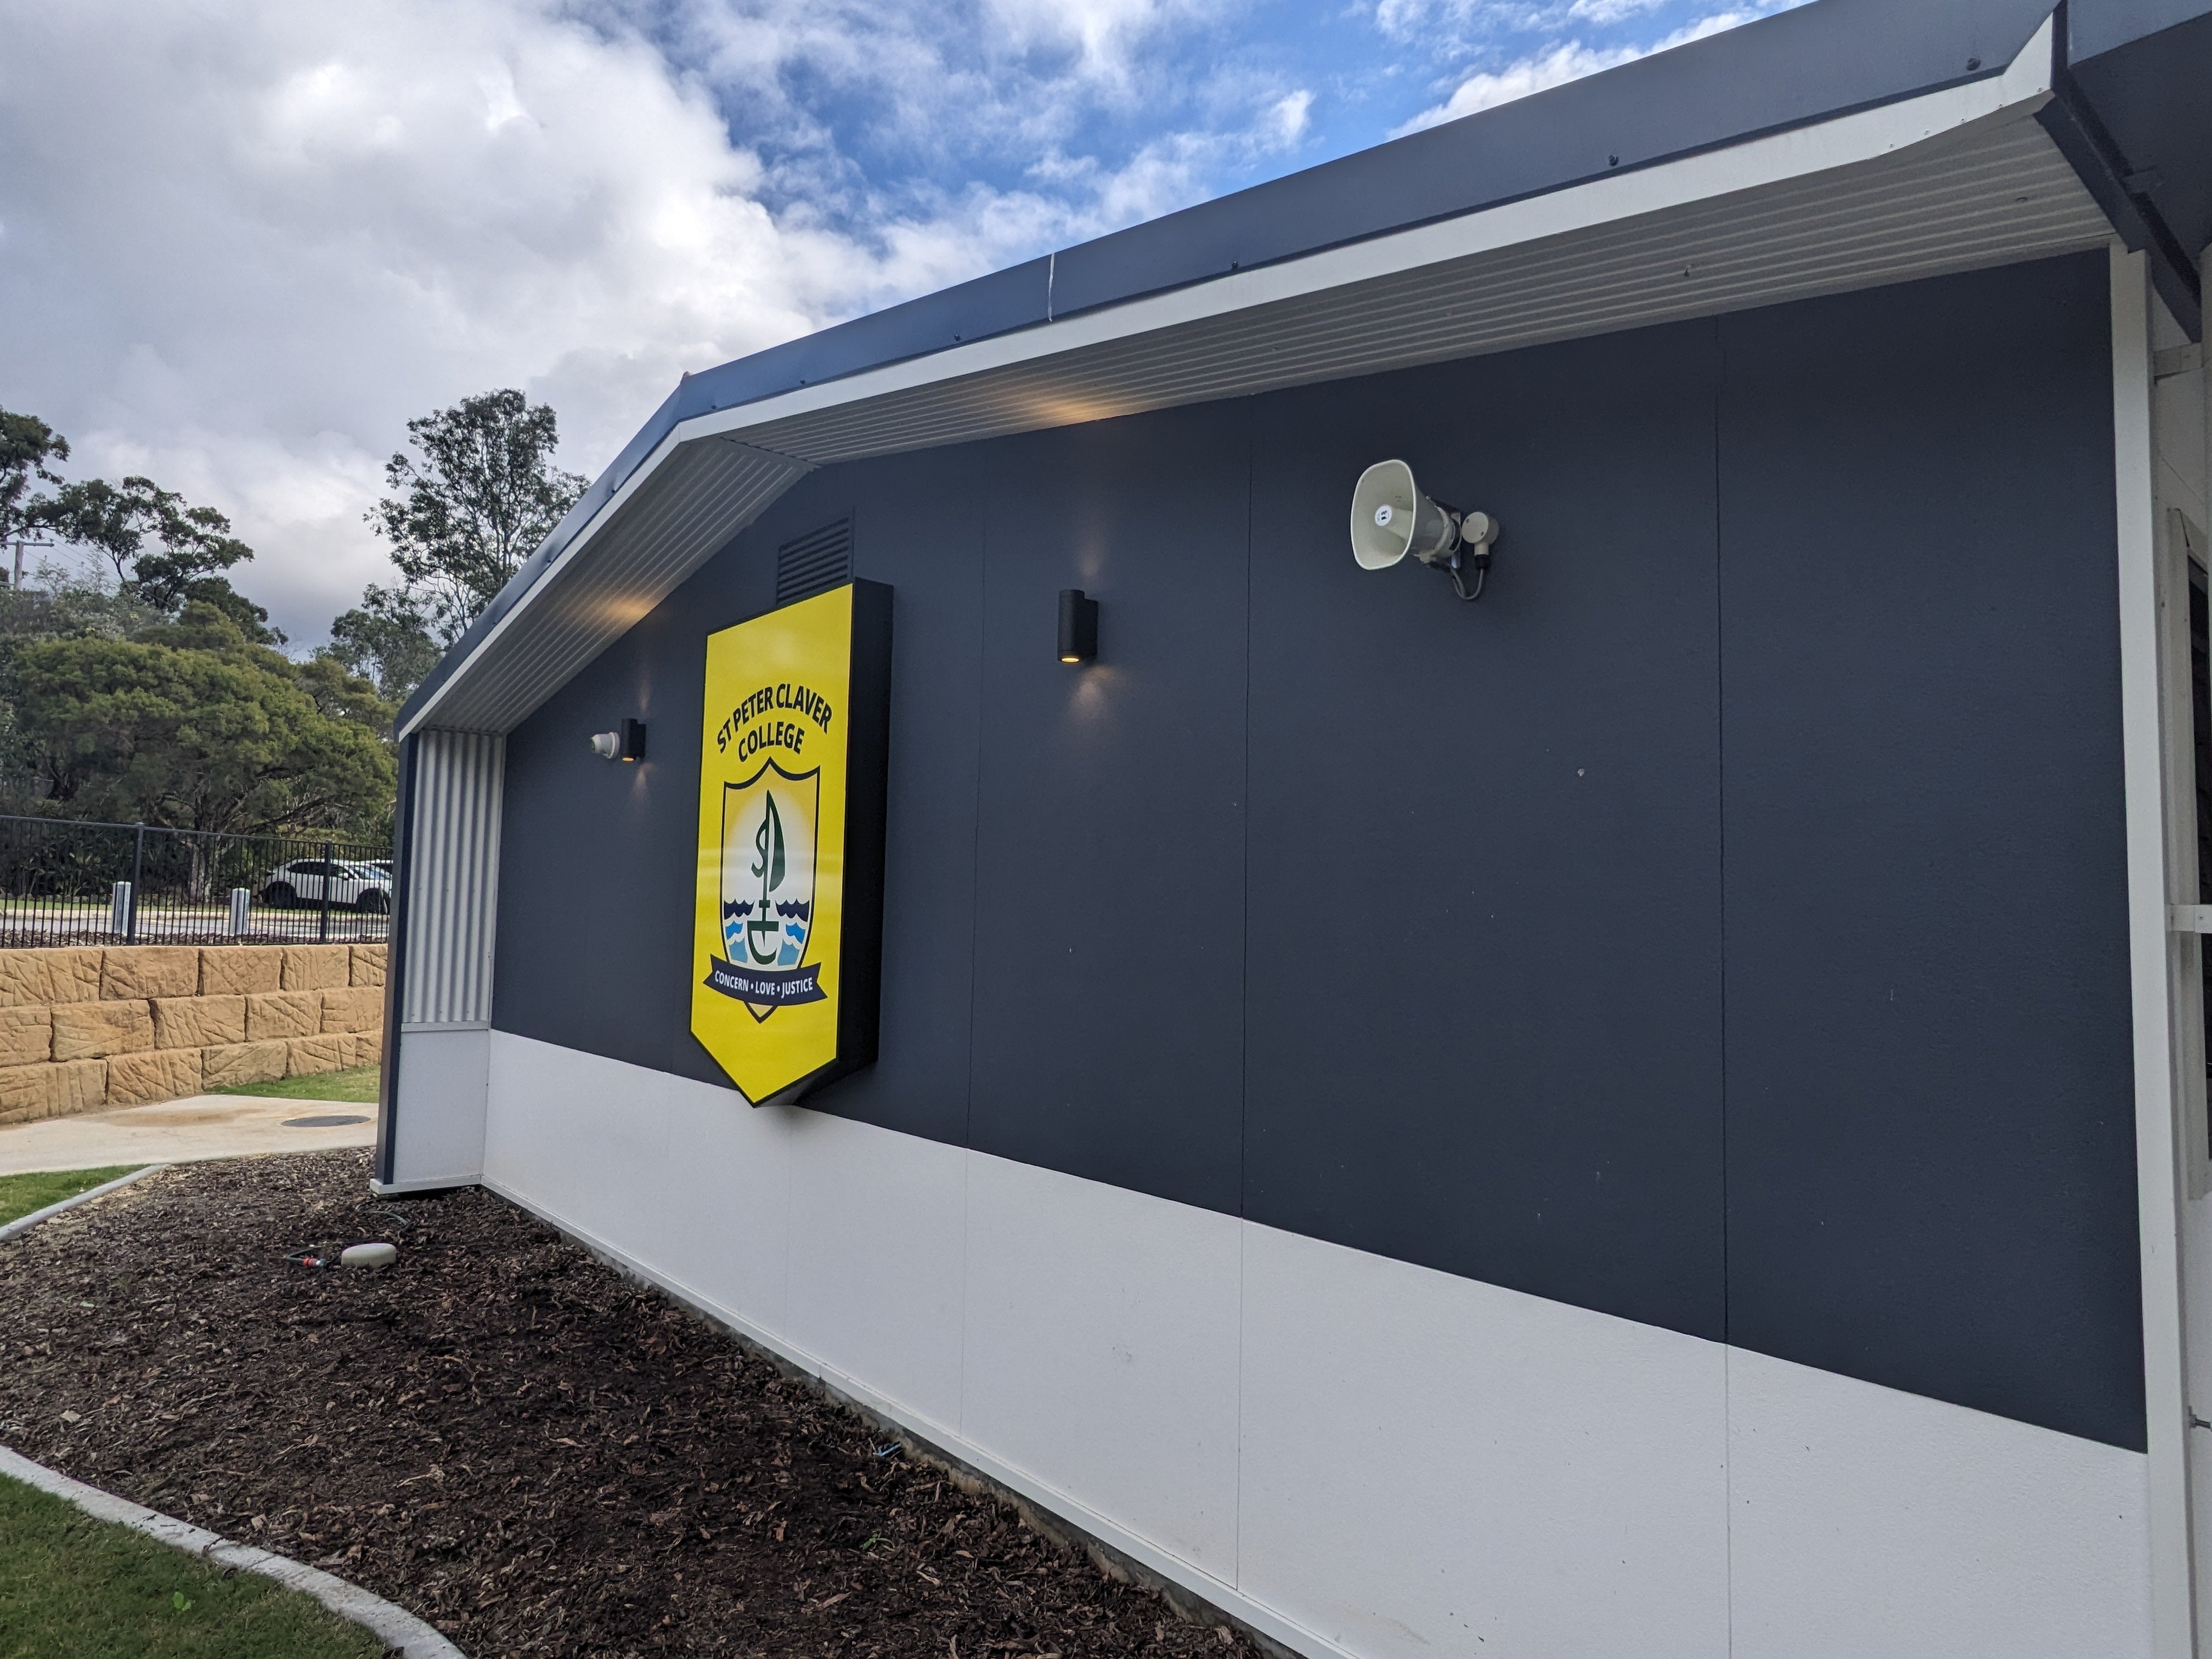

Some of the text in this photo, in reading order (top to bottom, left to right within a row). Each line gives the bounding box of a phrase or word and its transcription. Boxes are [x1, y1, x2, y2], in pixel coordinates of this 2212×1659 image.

[718, 684, 832, 753] ST PETER CLAVER
[738, 721, 805, 762] COLLEGE
[715, 970, 813, 998] CONCERN LOVE JUSTICE
